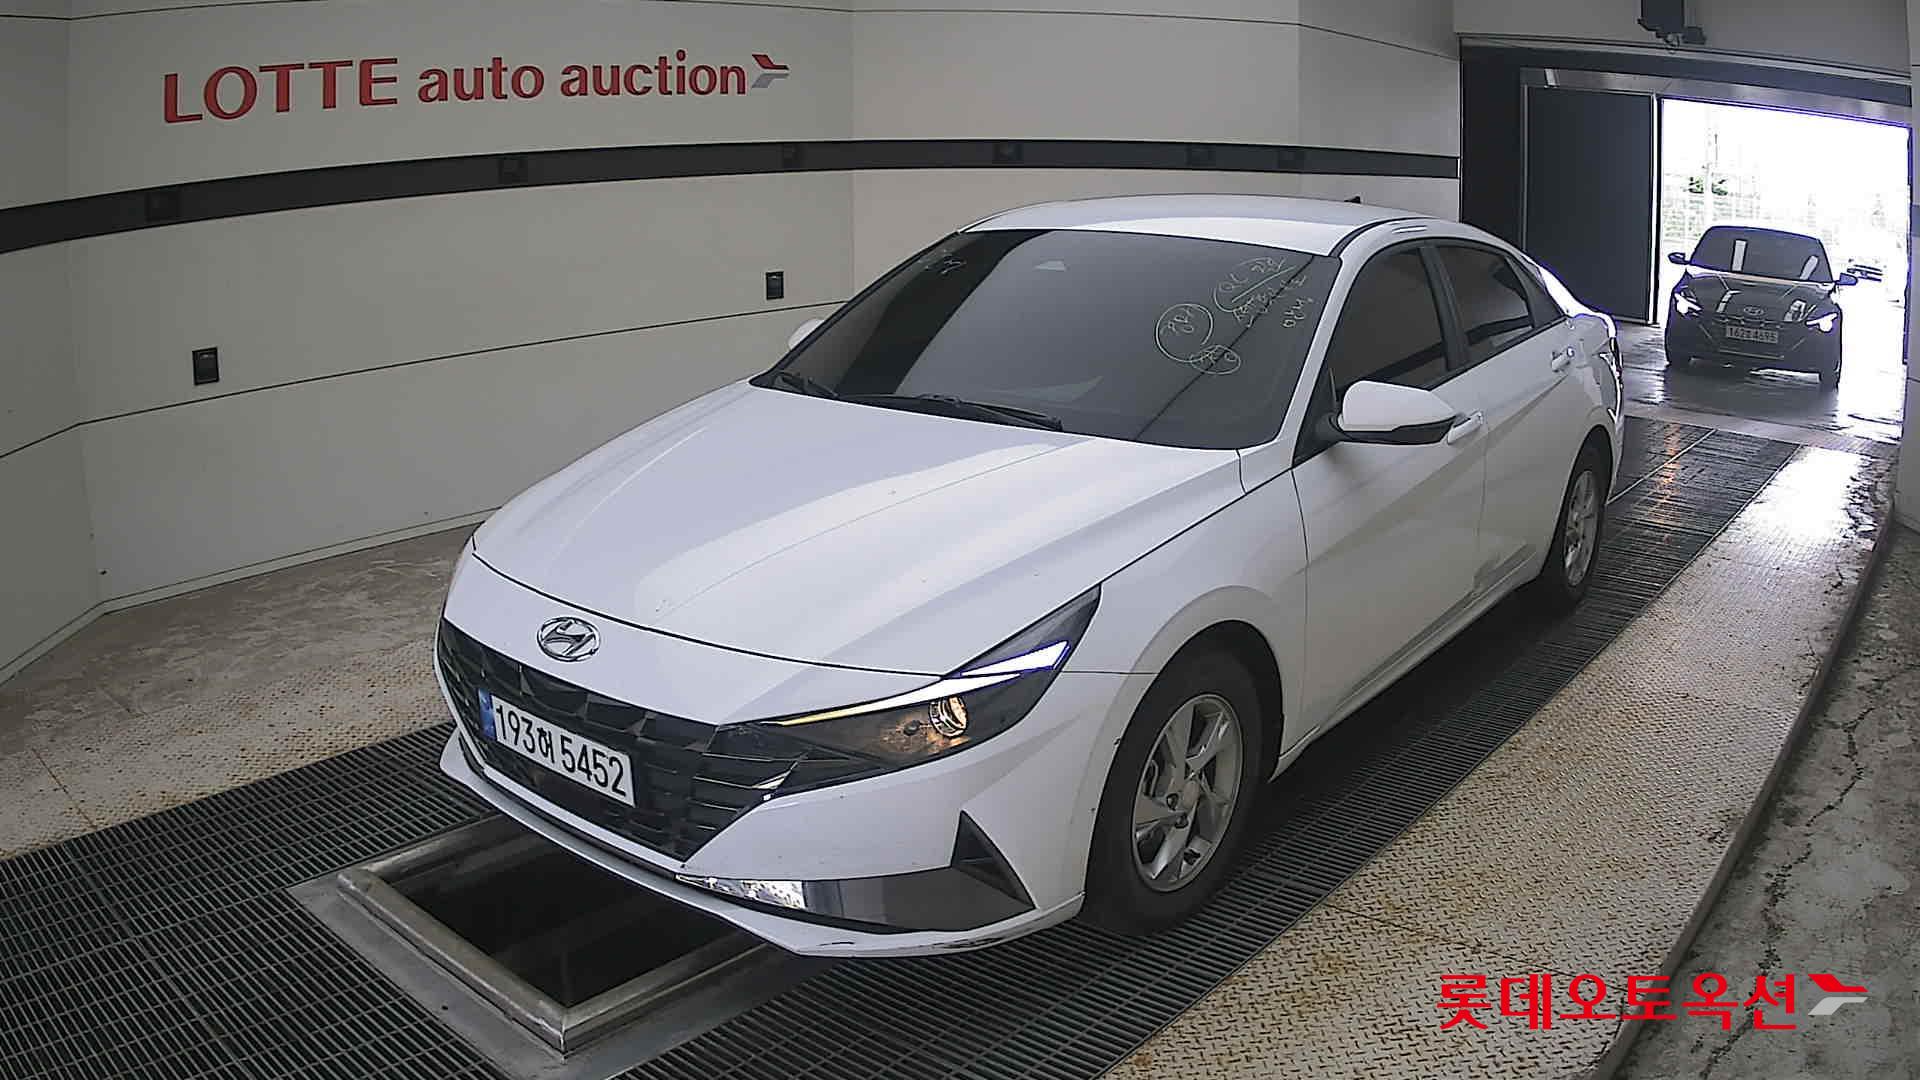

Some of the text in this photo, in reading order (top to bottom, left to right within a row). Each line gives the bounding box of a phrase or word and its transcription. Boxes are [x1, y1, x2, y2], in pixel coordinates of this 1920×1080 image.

[164, 51, 747, 124] LOTTE auto auction
[496, 705, 627, 797] 193허 5452
